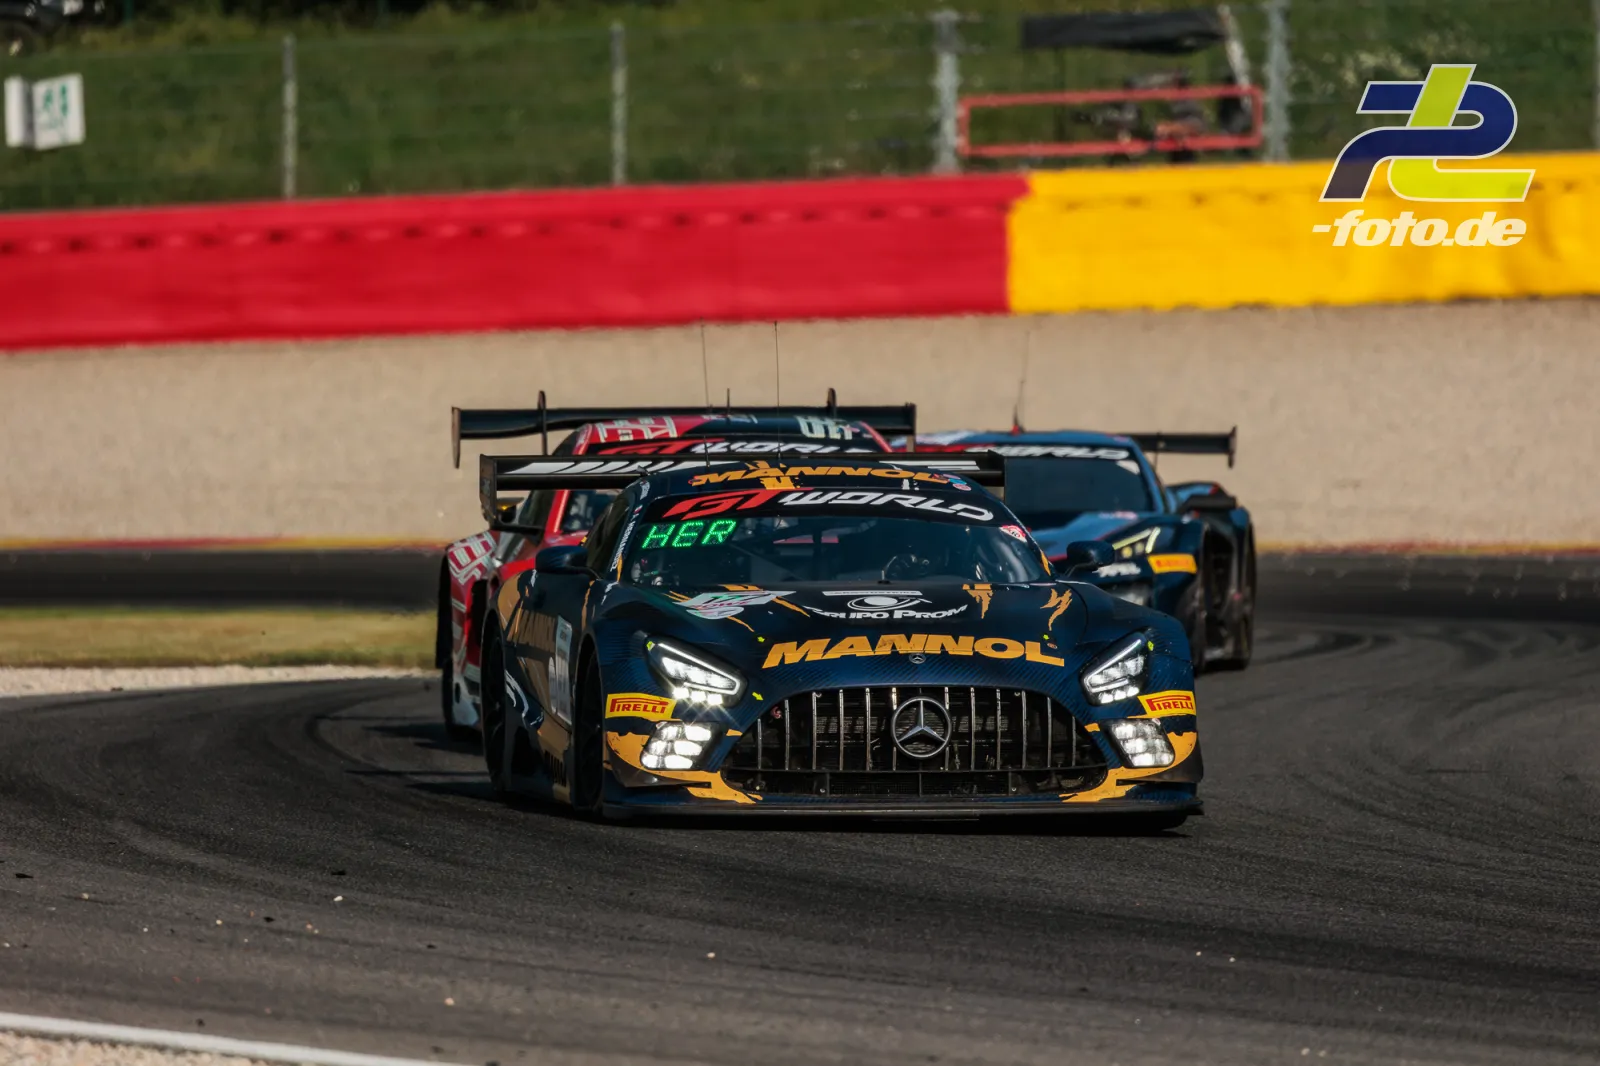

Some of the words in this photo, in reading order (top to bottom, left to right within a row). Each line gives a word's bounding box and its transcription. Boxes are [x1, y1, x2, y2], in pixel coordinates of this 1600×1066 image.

[690, 465, 950, 487] MANNOL
[663, 487, 814, 520] GT
[778, 491, 994, 521] WORLD
[641, 519, 738, 550] HER
[762, 633, 1065, 667] MANNOL
[609, 696, 670, 715] PIRELLI
[1147, 694, 1195, 711] PIRELLI
